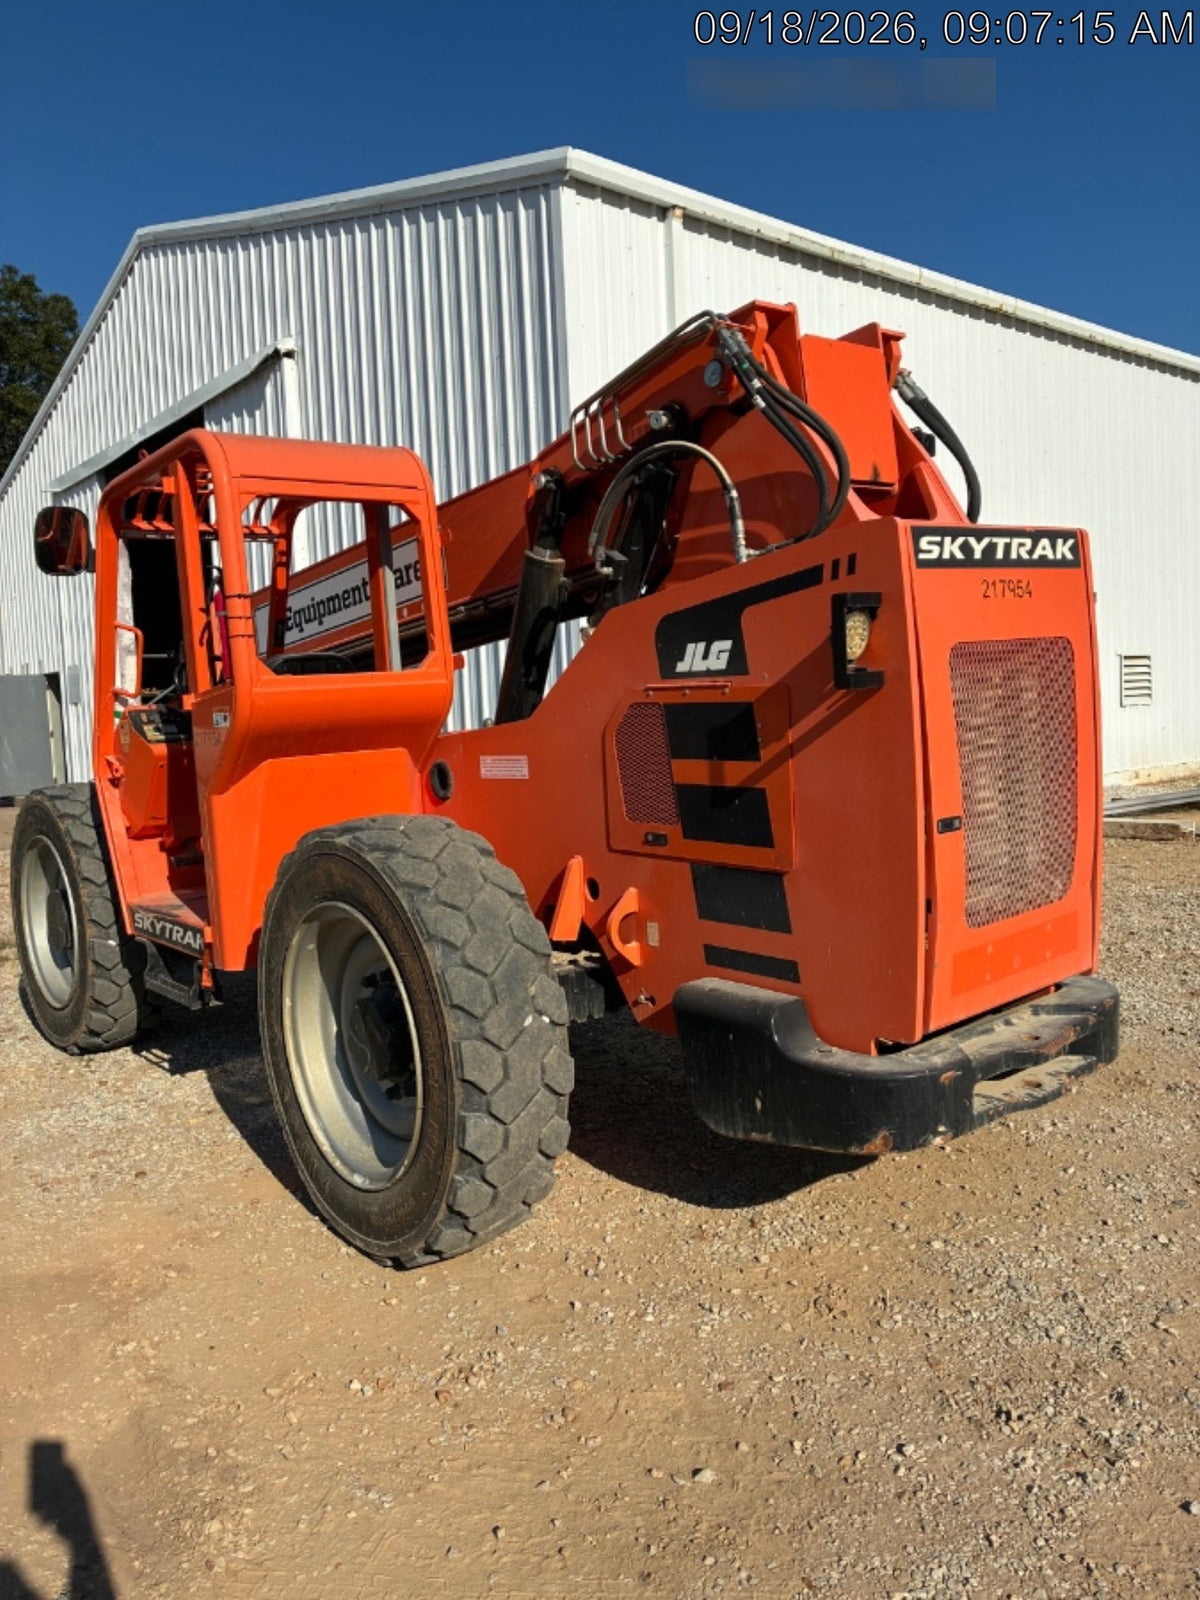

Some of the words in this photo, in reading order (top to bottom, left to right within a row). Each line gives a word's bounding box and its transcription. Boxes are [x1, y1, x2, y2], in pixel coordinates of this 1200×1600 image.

[917, 535, 1076, 561] SKYTRAK
[981, 578, 1034, 599] 217954
[675, 639, 734, 673] JLG
